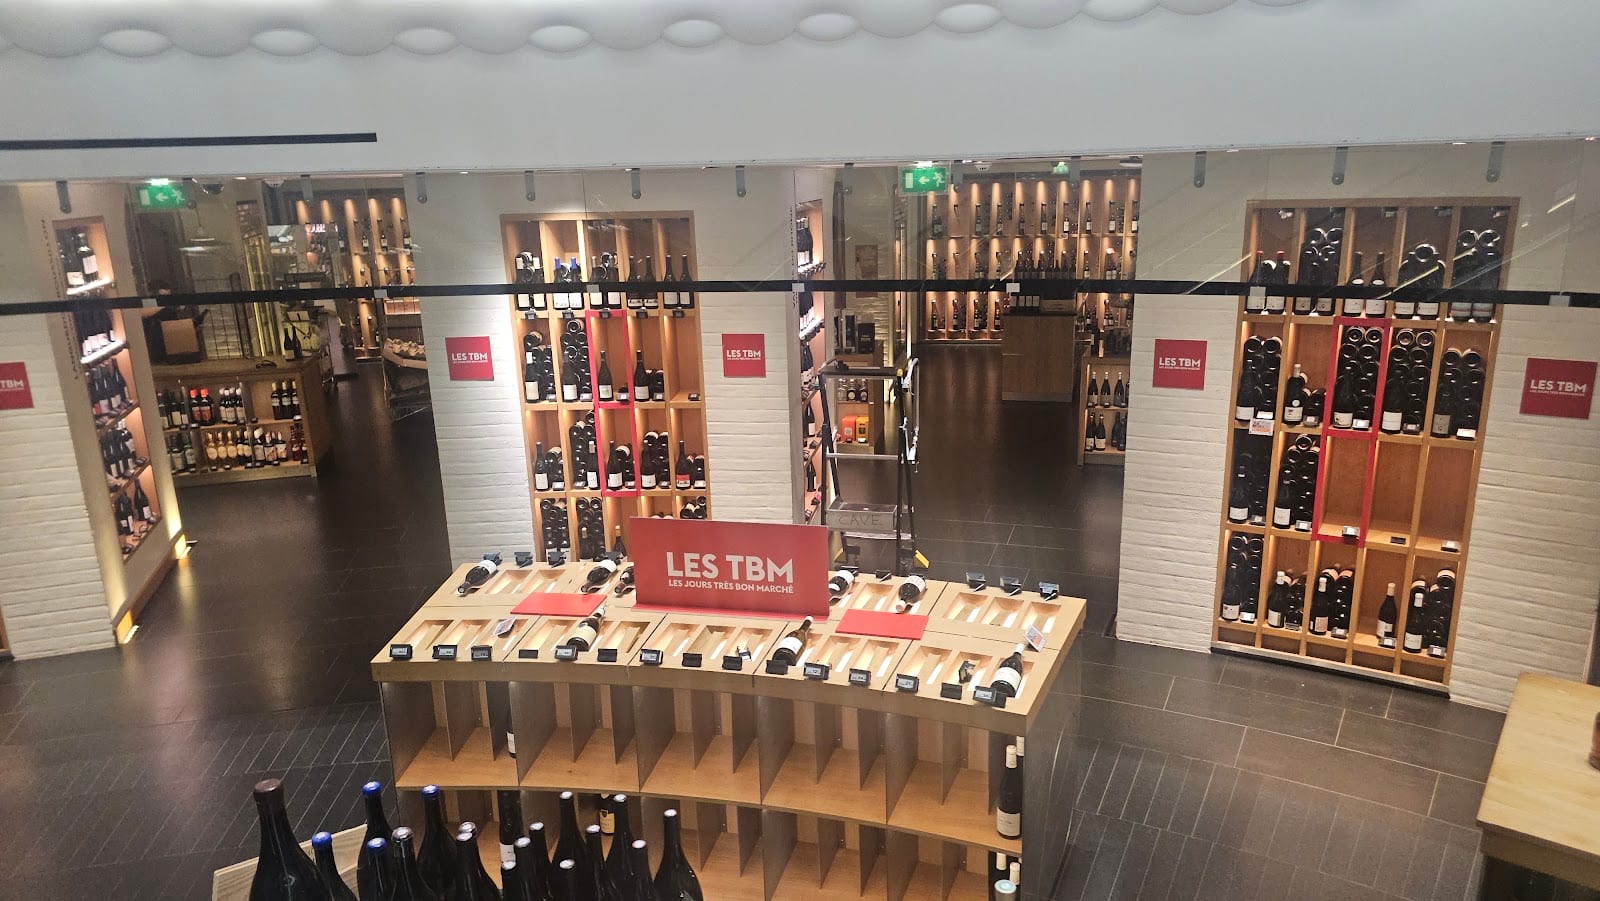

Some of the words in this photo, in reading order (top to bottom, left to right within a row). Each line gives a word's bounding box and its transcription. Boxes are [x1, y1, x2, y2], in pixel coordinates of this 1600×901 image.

[452, 353, 467, 361] LES
[468, 352, 488, 360] TBM
[727, 350, 741, 358] LES
[742, 350, 761, 358] TBM
[1159, 357, 1176, 366] LES
[1178, 358, 1201, 367] TBM
[1530, 379, 1553, 390] LES
[1557, 381, 1587, 393] TBM
[838, 513, 881, 526] CAVE
[666, 551, 719, 579] LES
[725, 554, 794, 583] TBM
[668, 579, 683, 587] LES
[684, 580, 712, 589] JOURS
[735, 583, 755, 591] BON
[756, 584, 794, 594] MARCHÉ
